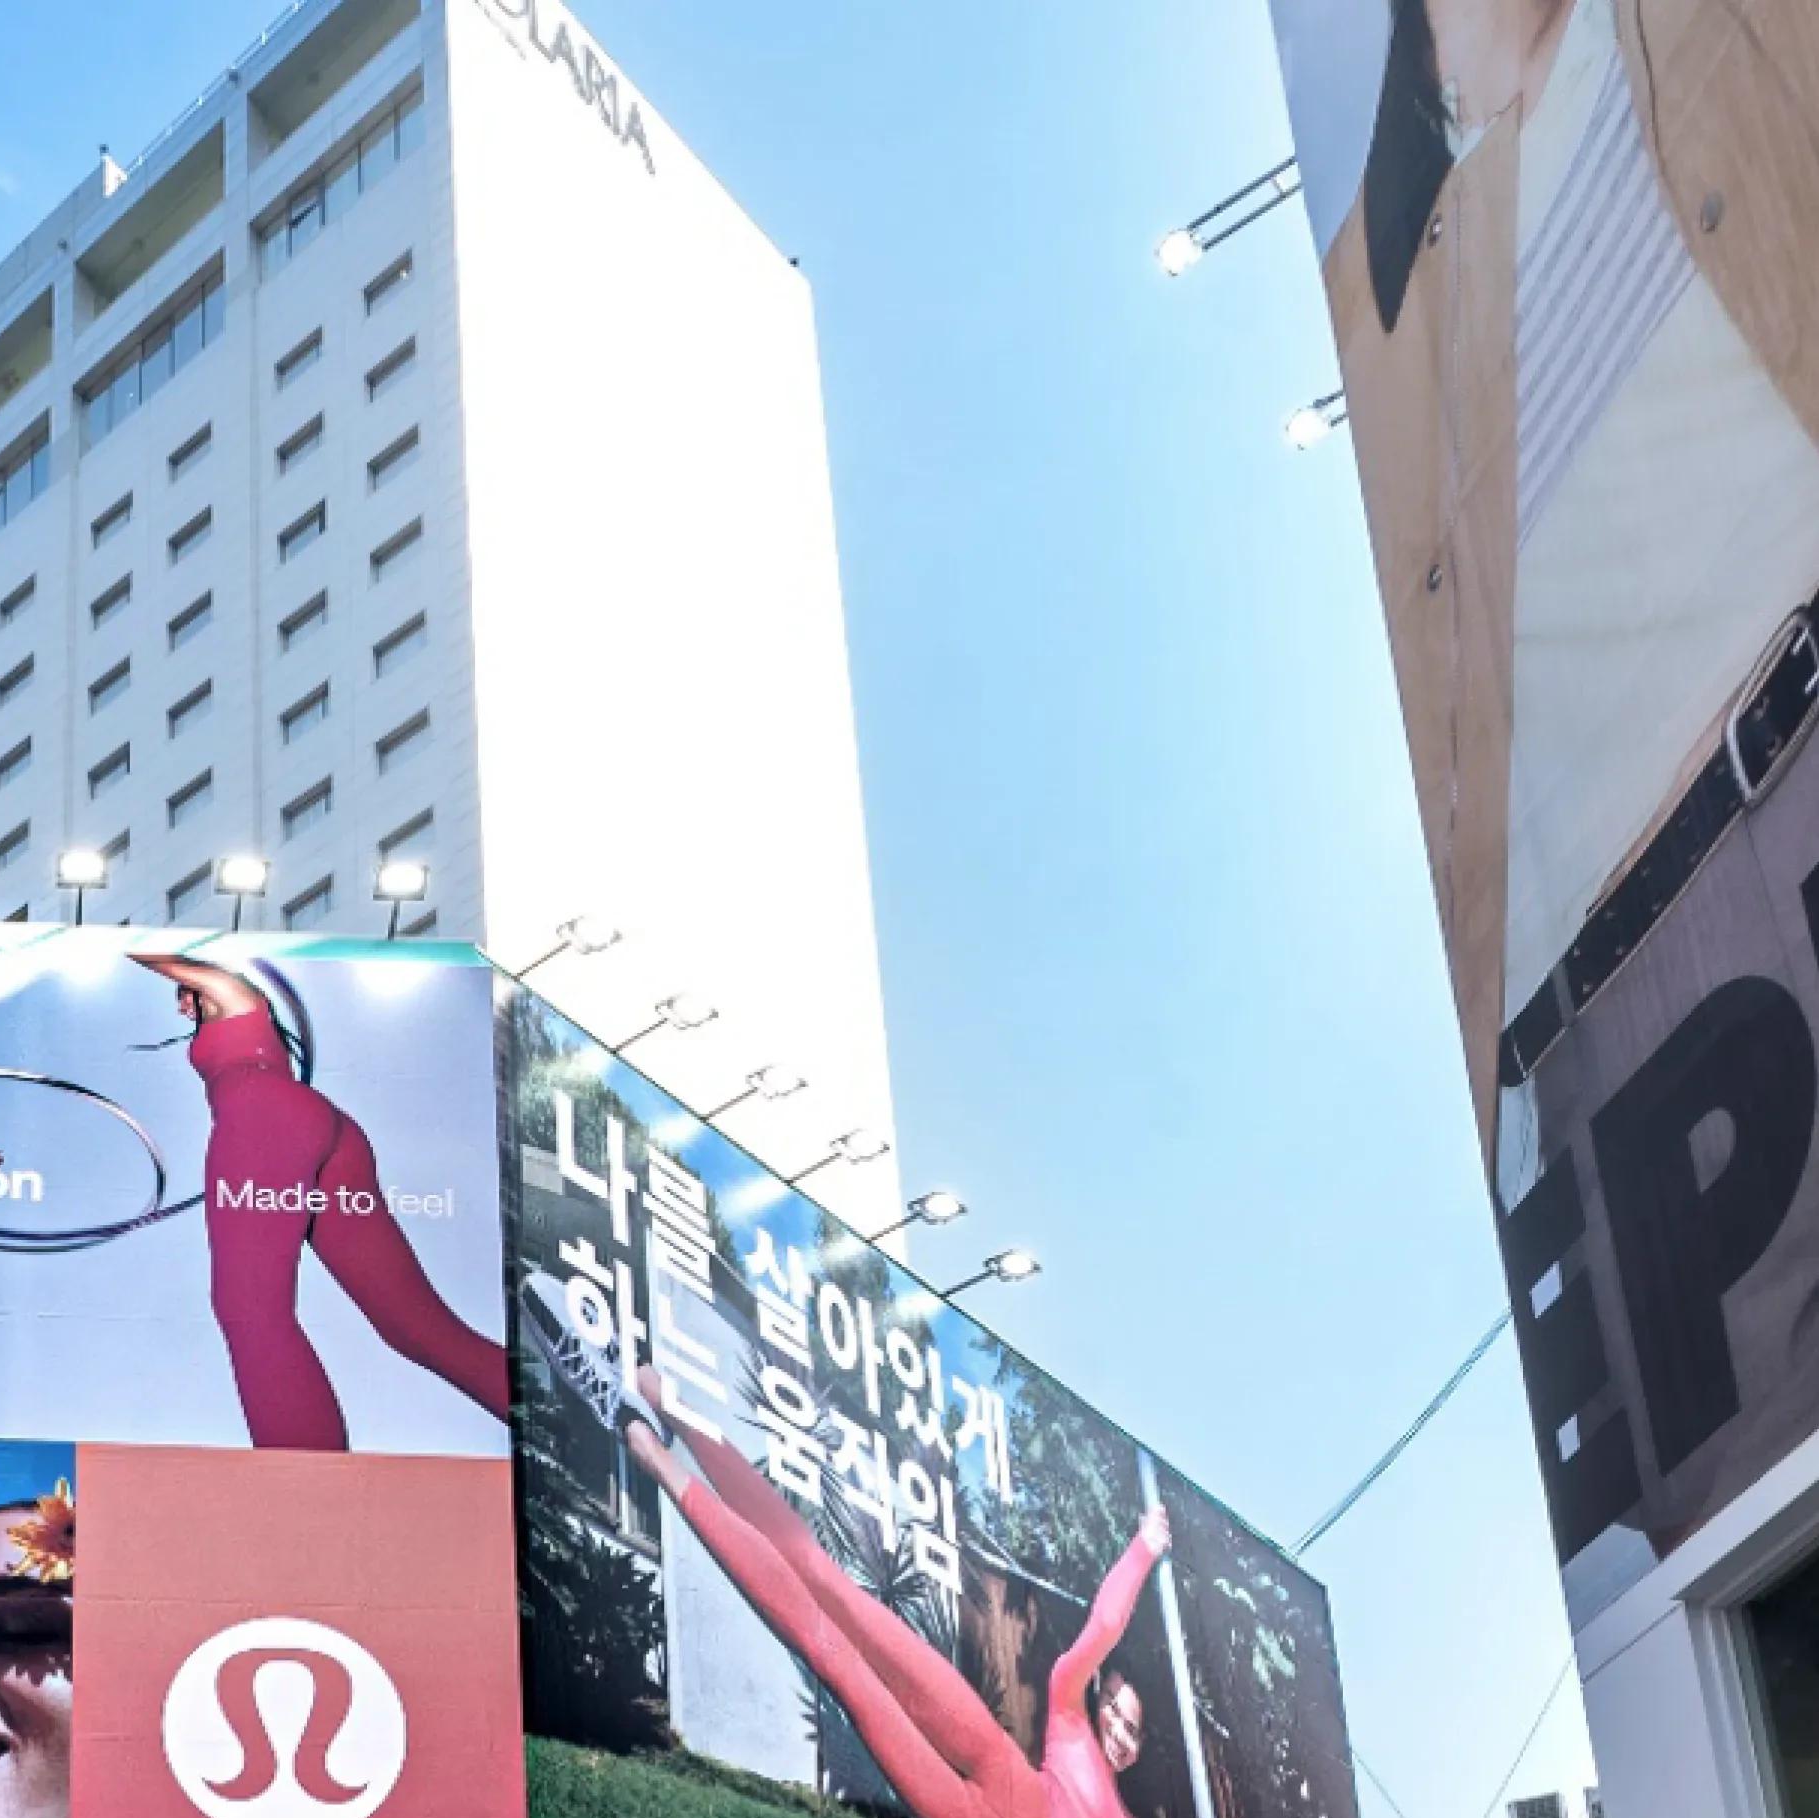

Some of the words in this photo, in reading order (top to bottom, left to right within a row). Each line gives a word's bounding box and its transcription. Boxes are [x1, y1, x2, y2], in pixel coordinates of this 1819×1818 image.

[216, 1179, 329, 1212] Made
[334, 1184, 374, 1216] to
[385, 1186, 455, 1217] feel
[555, 1090, 716, 1302] 나를
[745, 1227, 1013, 1504] 살아있게
[558, 1236, 727, 1443] 하는
[757, 1364, 963, 1595] 움직임
